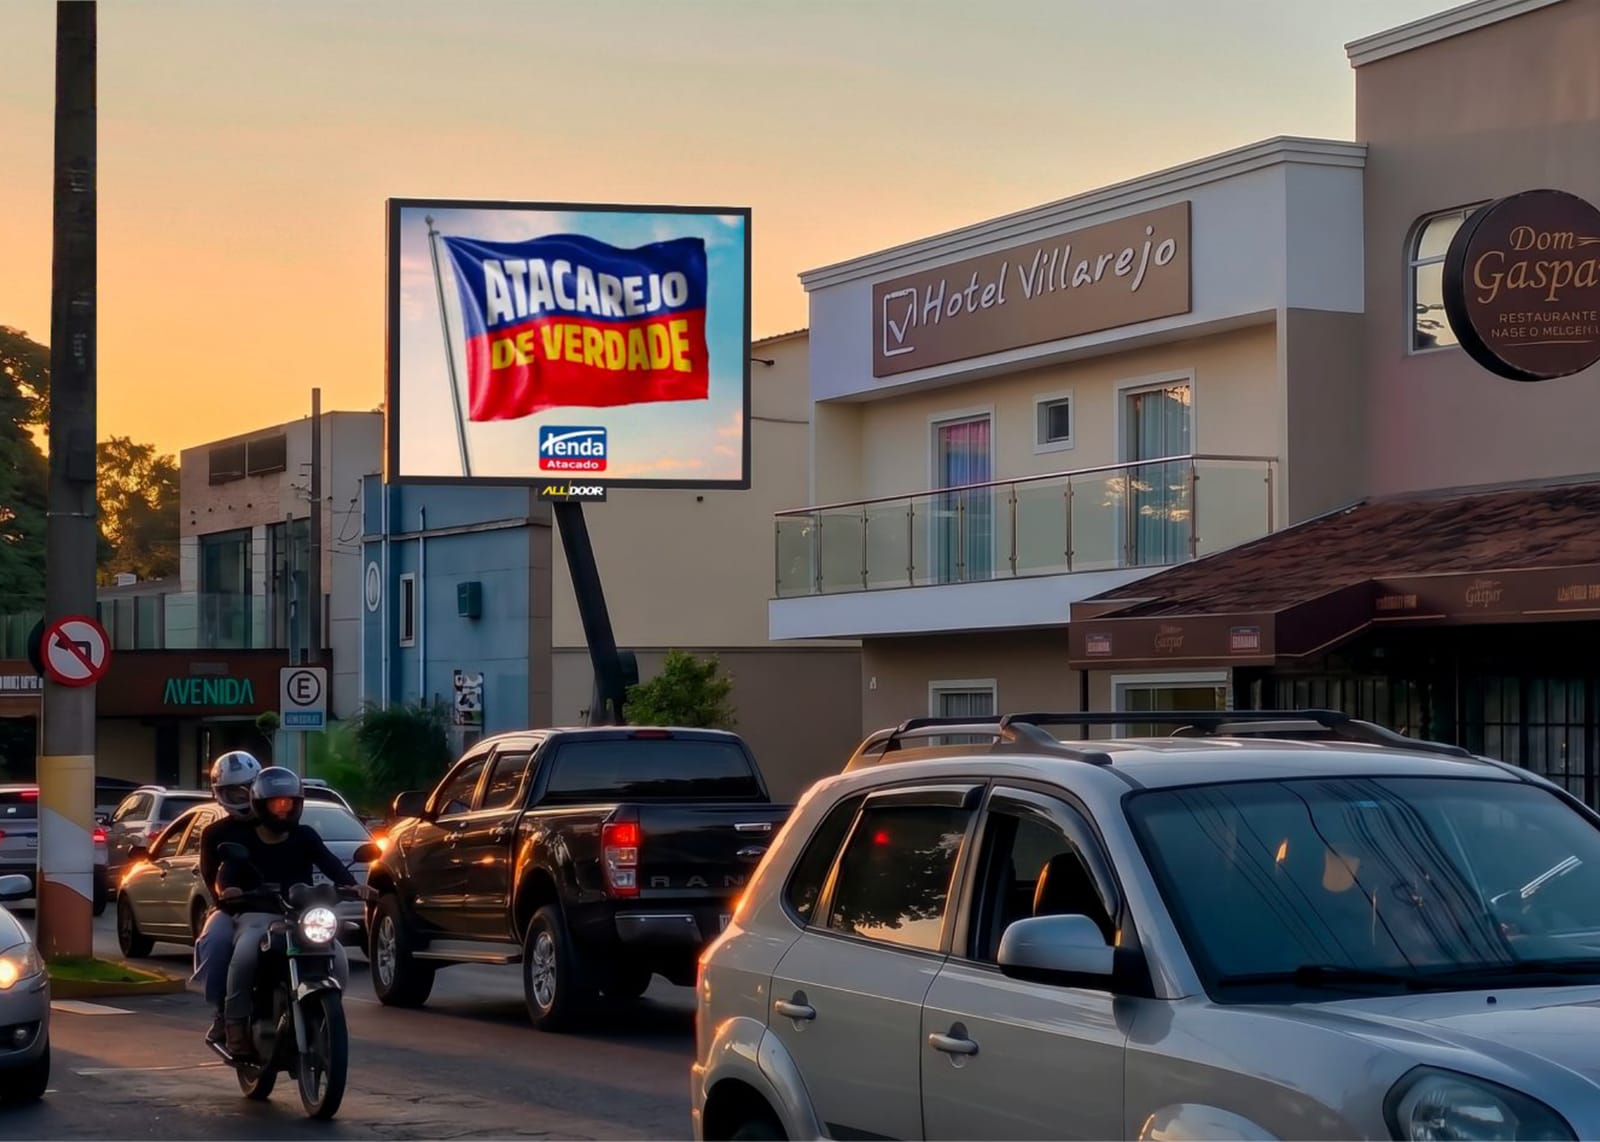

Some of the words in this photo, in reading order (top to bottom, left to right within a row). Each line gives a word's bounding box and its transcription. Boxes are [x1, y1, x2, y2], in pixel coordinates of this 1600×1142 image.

[1509, 226, 1574, 250] Dom
[923, 261, 1009, 325] Hotel
[1018, 225, 1177, 299] Villarejo
[1473, 251, 1600, 304] Gaspa
[483, 258, 689, 326] ATACAREJO
[1499, 311, 1598, 323] RESTAURANTE
[491, 329, 535, 370] DE
[540, 319, 693, 373] VERDADE
[547, 460, 599, 470] Atacado
[163, 678, 255, 705] AVENIDA
[297, 677, 312, 699] E
